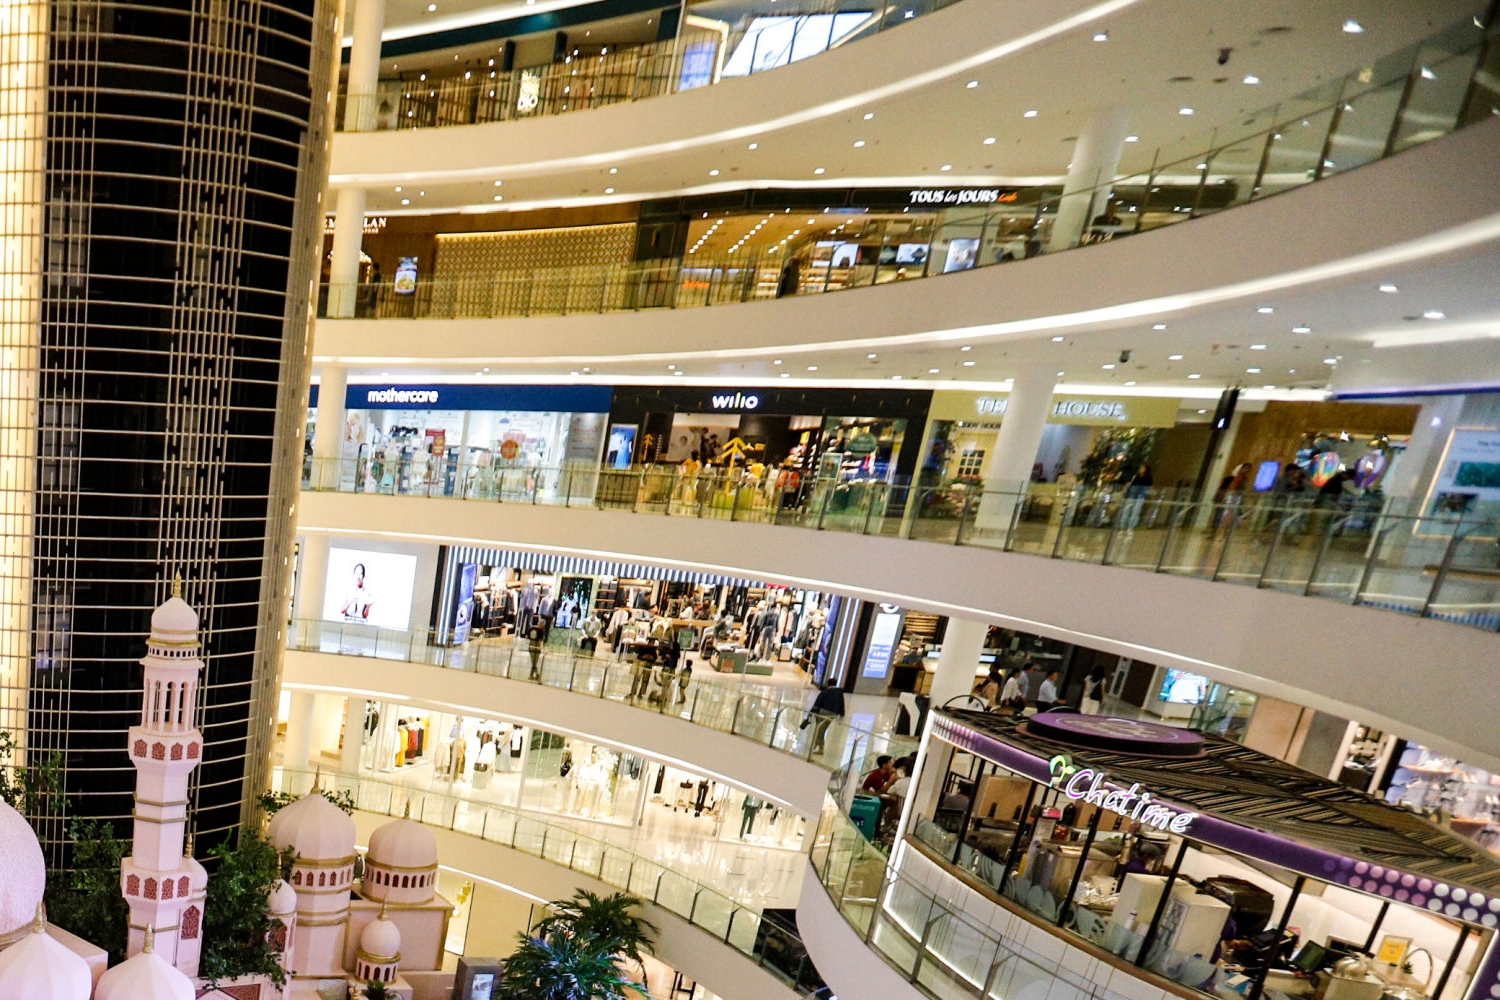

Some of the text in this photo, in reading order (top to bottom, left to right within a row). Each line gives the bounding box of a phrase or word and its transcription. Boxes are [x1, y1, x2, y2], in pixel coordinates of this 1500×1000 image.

[910, 190, 945, 203] TOUS
[956, 190, 1000, 206] JOURS
[367, 387, 439, 403] mothercare
[1052, 400, 1125, 419] HOUSE
[1065, 768, 1195, 834] Chatime
